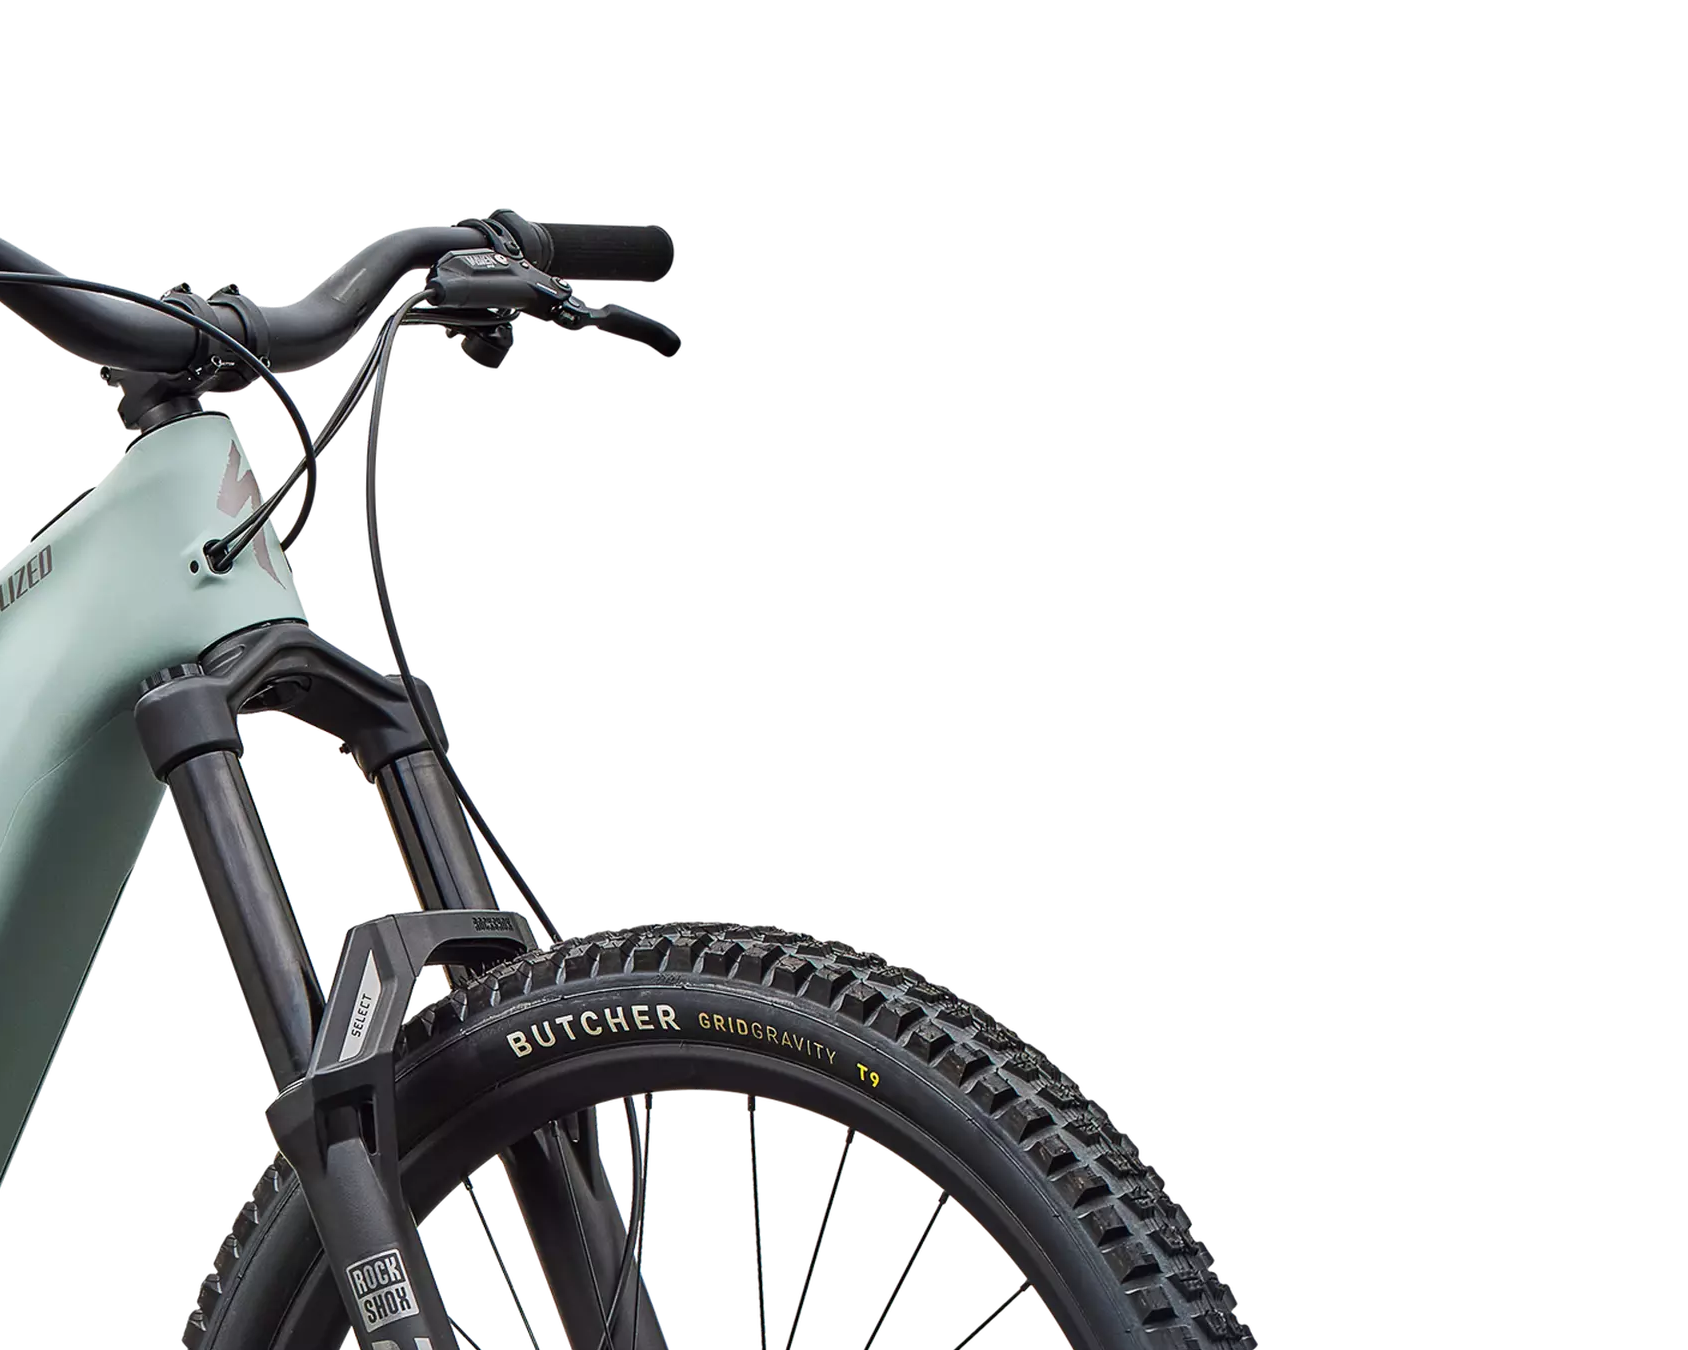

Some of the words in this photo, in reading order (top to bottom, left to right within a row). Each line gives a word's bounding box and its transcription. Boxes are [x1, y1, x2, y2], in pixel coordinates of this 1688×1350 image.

[351, 993, 372, 1038] SELECT
[505, 1004, 682, 1059] BUTCHER
[698, 1012, 837, 1065] GRIDGRAVITY
[855, 1062, 881, 1088] T9
[352, 1255, 402, 1295] ROCK
[363, 1286, 412, 1324] SHOX
